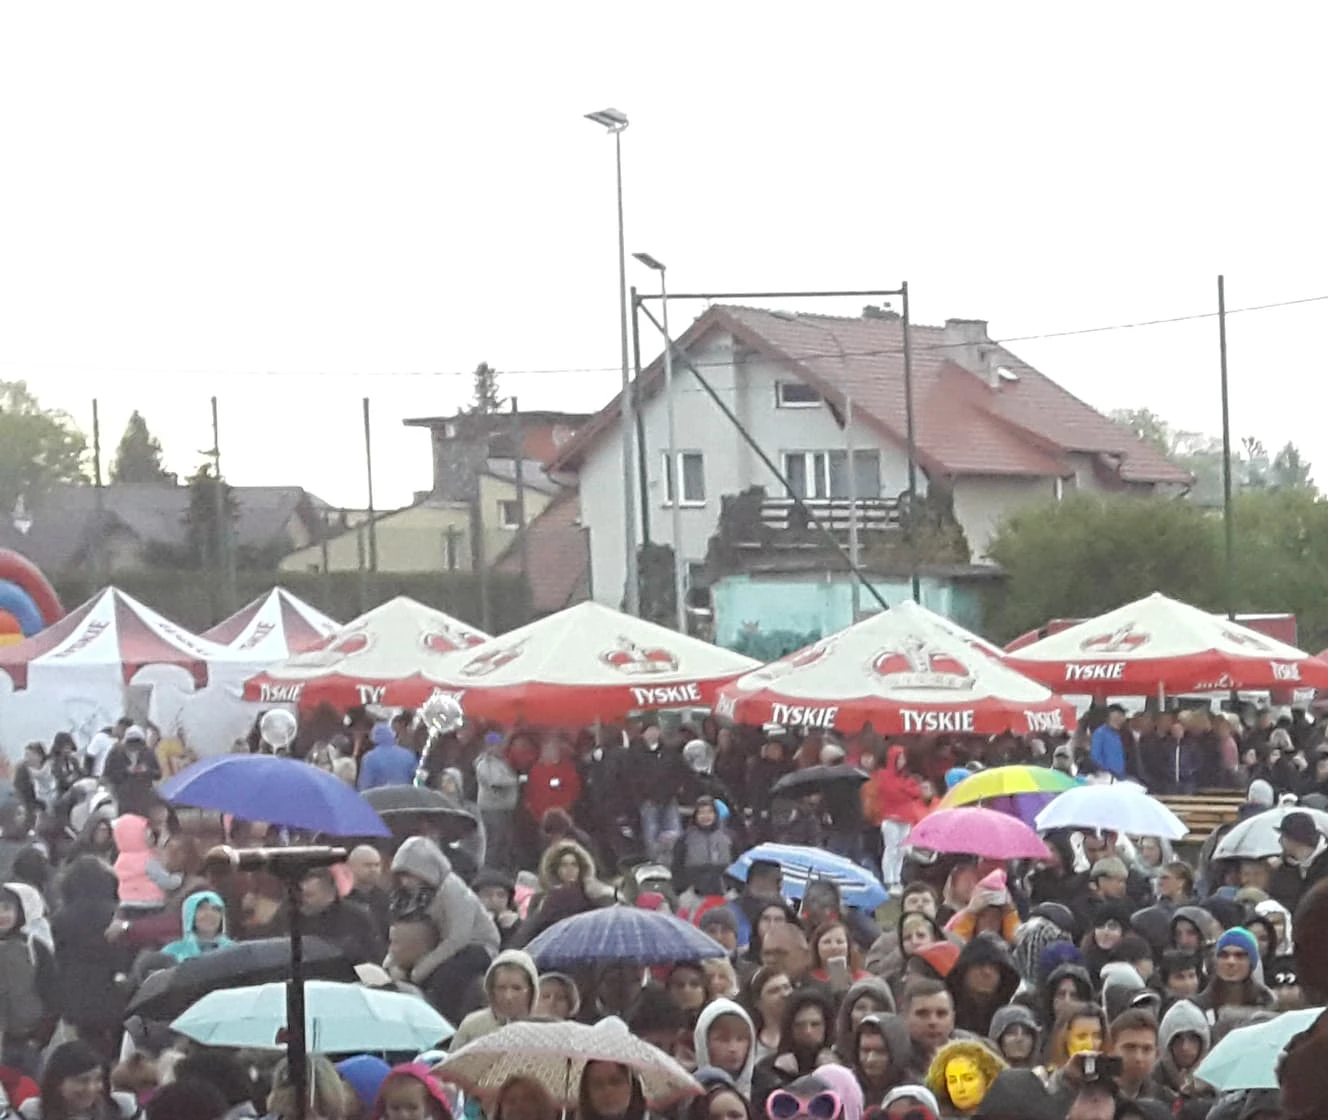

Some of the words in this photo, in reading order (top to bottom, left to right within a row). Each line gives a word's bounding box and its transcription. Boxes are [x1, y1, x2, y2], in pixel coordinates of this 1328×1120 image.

[1065, 661, 1127, 681] TYSKIE
[630, 683, 702, 705] TYSKIE
[771, 702, 839, 728] TYSKIE
[898, 708, 975, 732] TYSKIE
[1023, 708, 1065, 732] TYSKIE
